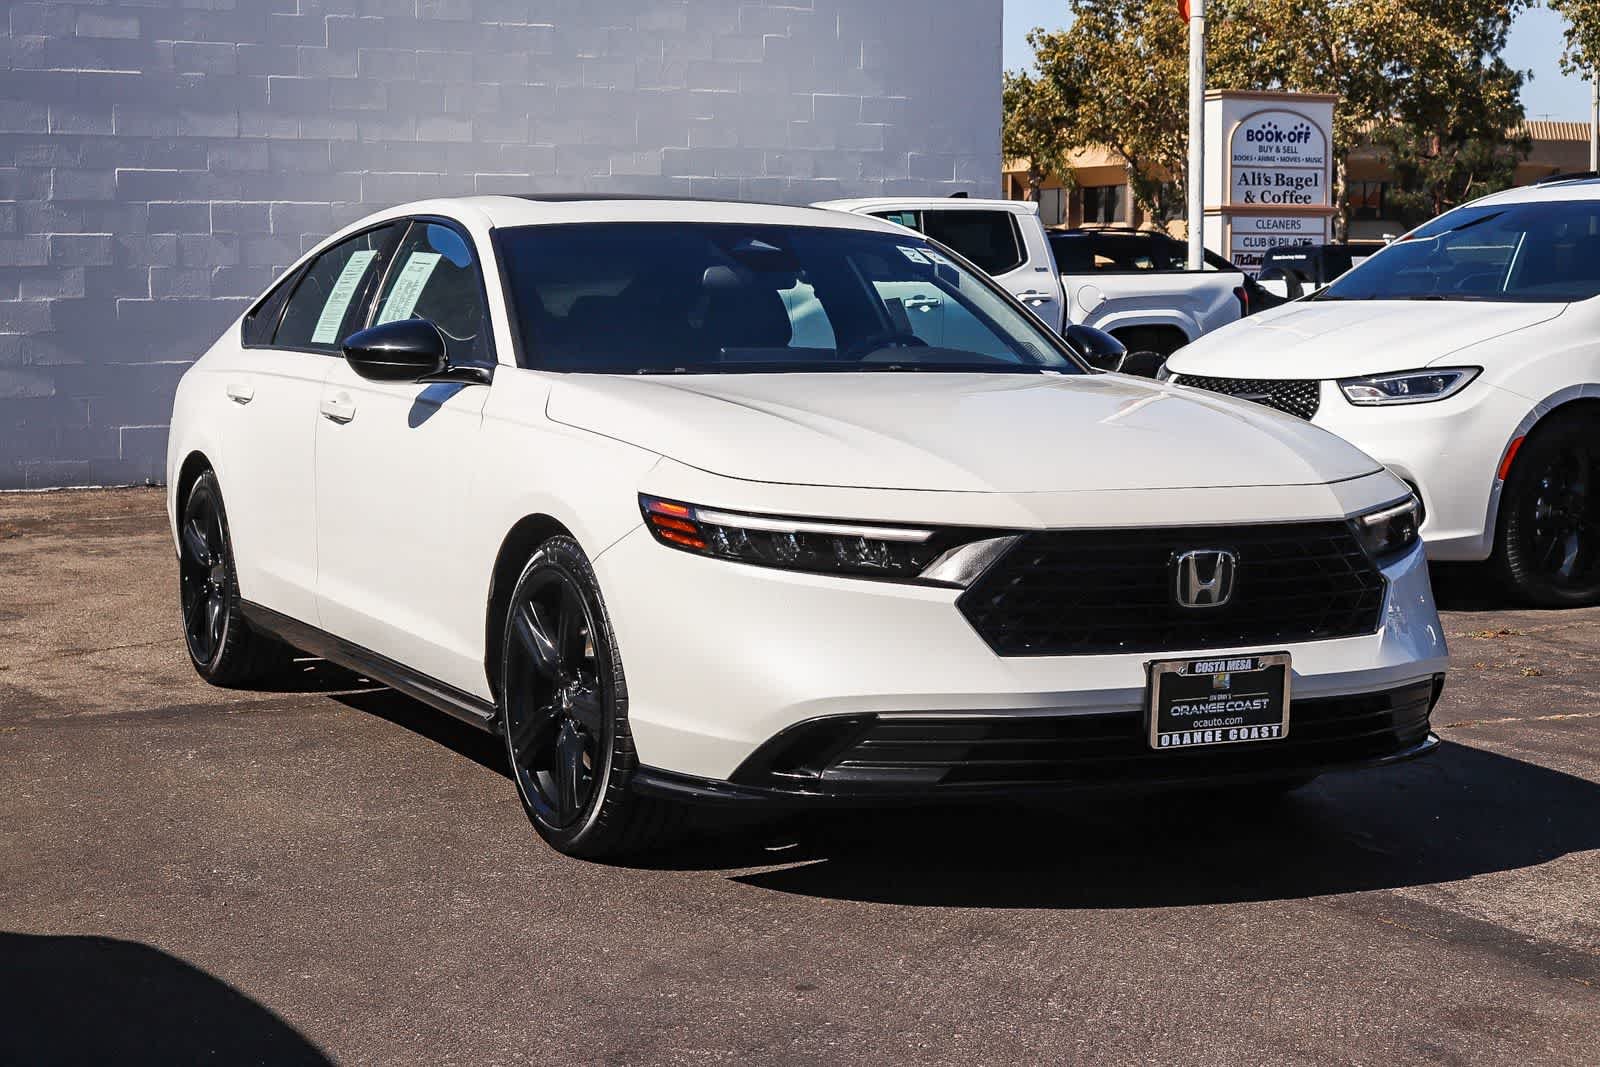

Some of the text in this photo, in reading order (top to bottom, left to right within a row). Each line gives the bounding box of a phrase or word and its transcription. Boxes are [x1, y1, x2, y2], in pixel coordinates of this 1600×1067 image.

[1258, 145, 1298, 154] BUY & SELL
[1237, 172, 1318, 190] Ali's Bagel
[1244, 190, 1312, 204] & Coffee
[1255, 219, 1301, 230] CLEANERS
[1243, 237, 1266, 247] CLUB
[1195, 659, 1252, 673] COSTA MESA
[1193, 716, 1243, 728] ocauto.com
[1161, 726, 1280, 746] ORANGE COAST
